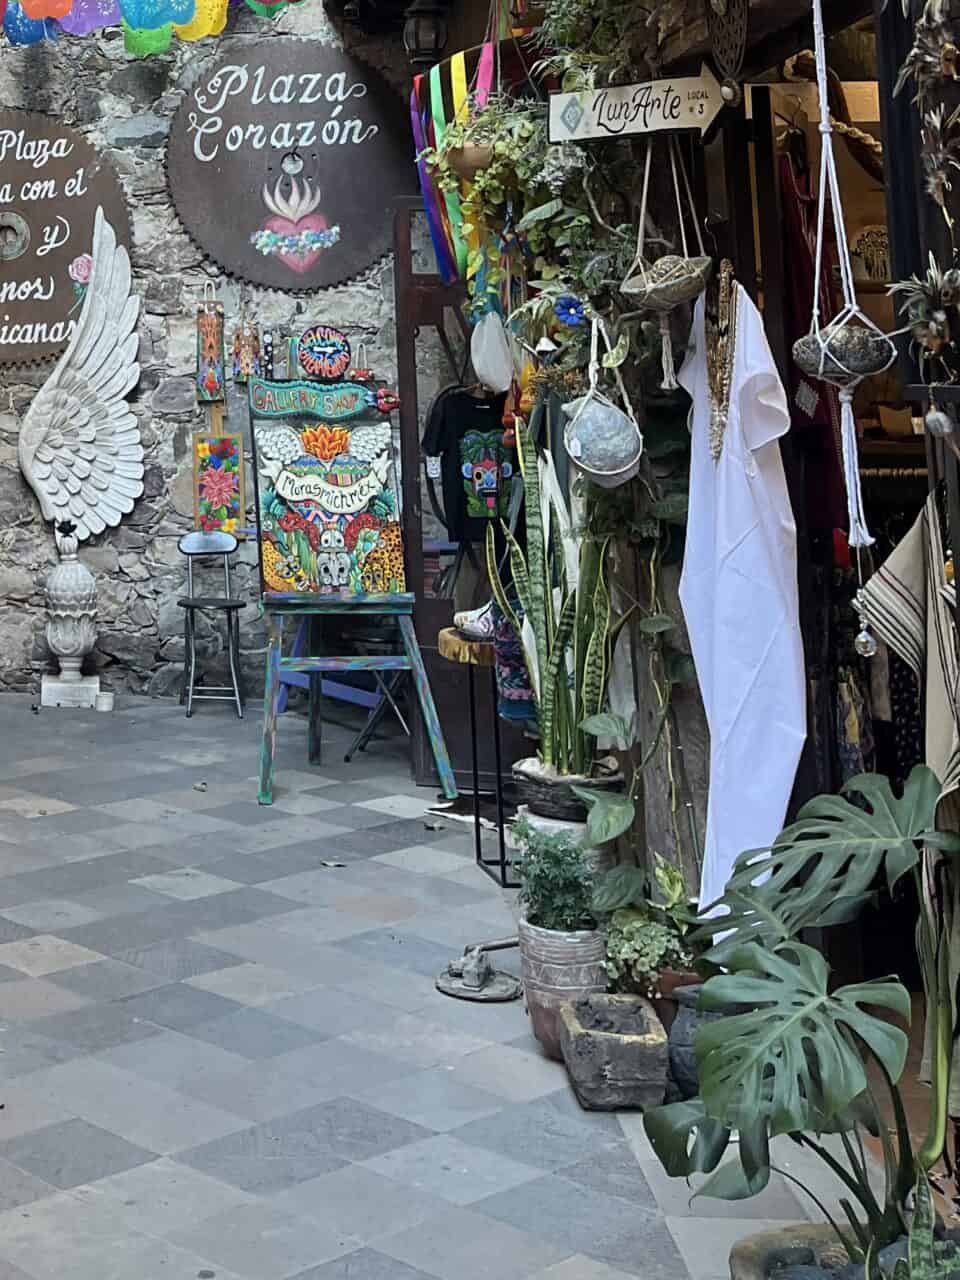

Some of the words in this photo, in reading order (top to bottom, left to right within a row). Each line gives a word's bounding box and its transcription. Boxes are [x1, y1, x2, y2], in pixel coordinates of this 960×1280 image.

[194, 63, 368, 114] Plaza
[592, 84, 681, 133] LunArte
[186, 104, 379, 162] Corazón
[20, 178, 58, 201] con
[64, 167, 88, 197] el
[36, 215, 71, 256] y
[253, 384, 317, 412] GALLERY
